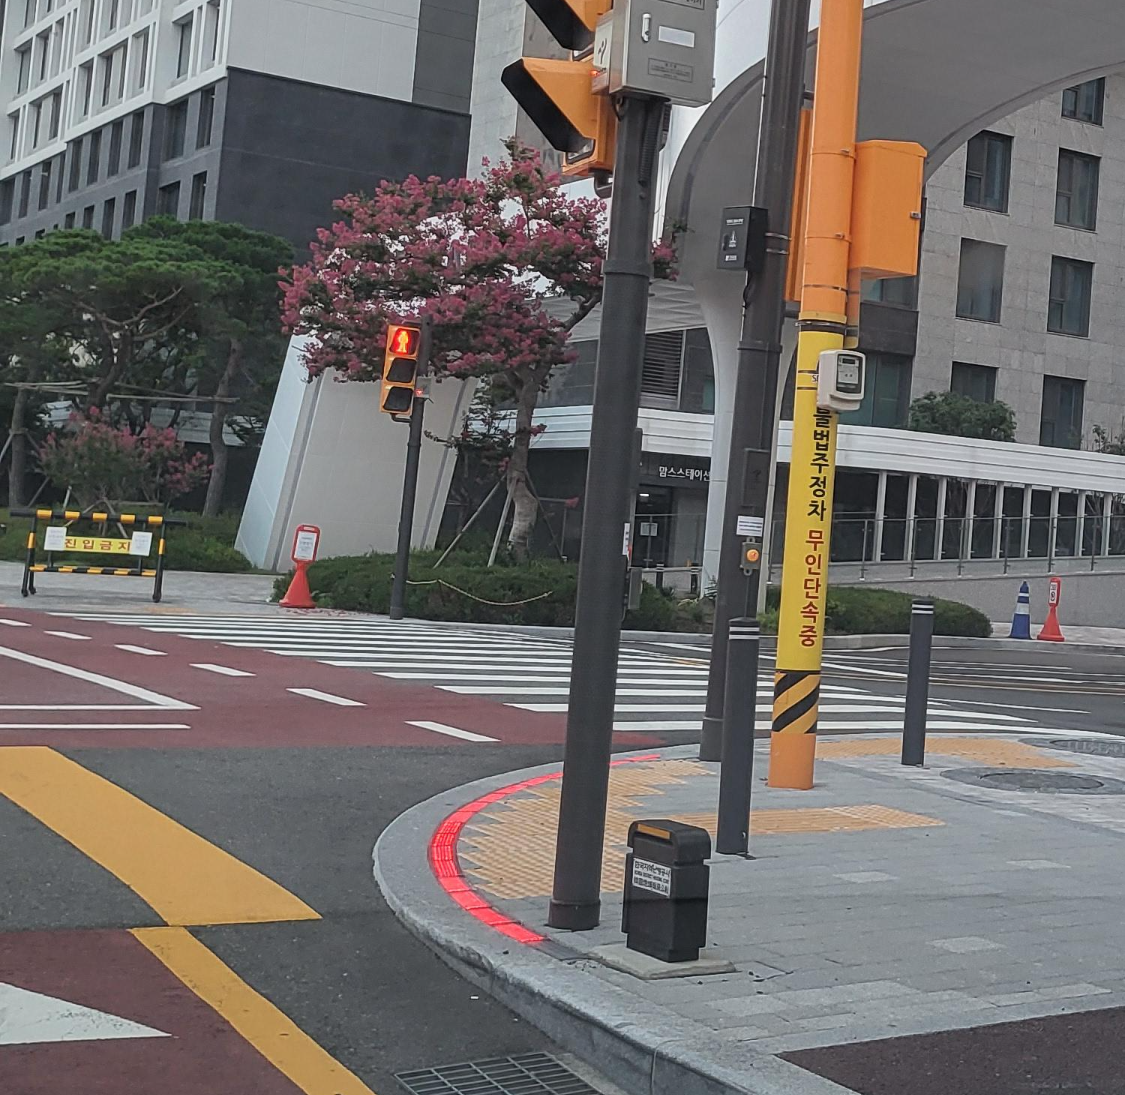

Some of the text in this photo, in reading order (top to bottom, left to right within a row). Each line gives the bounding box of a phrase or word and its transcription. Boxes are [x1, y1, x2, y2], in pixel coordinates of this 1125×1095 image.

[65, 537, 131, 552] 진입금지
[799, 407, 832, 647] 불법주정차 무인단속중
